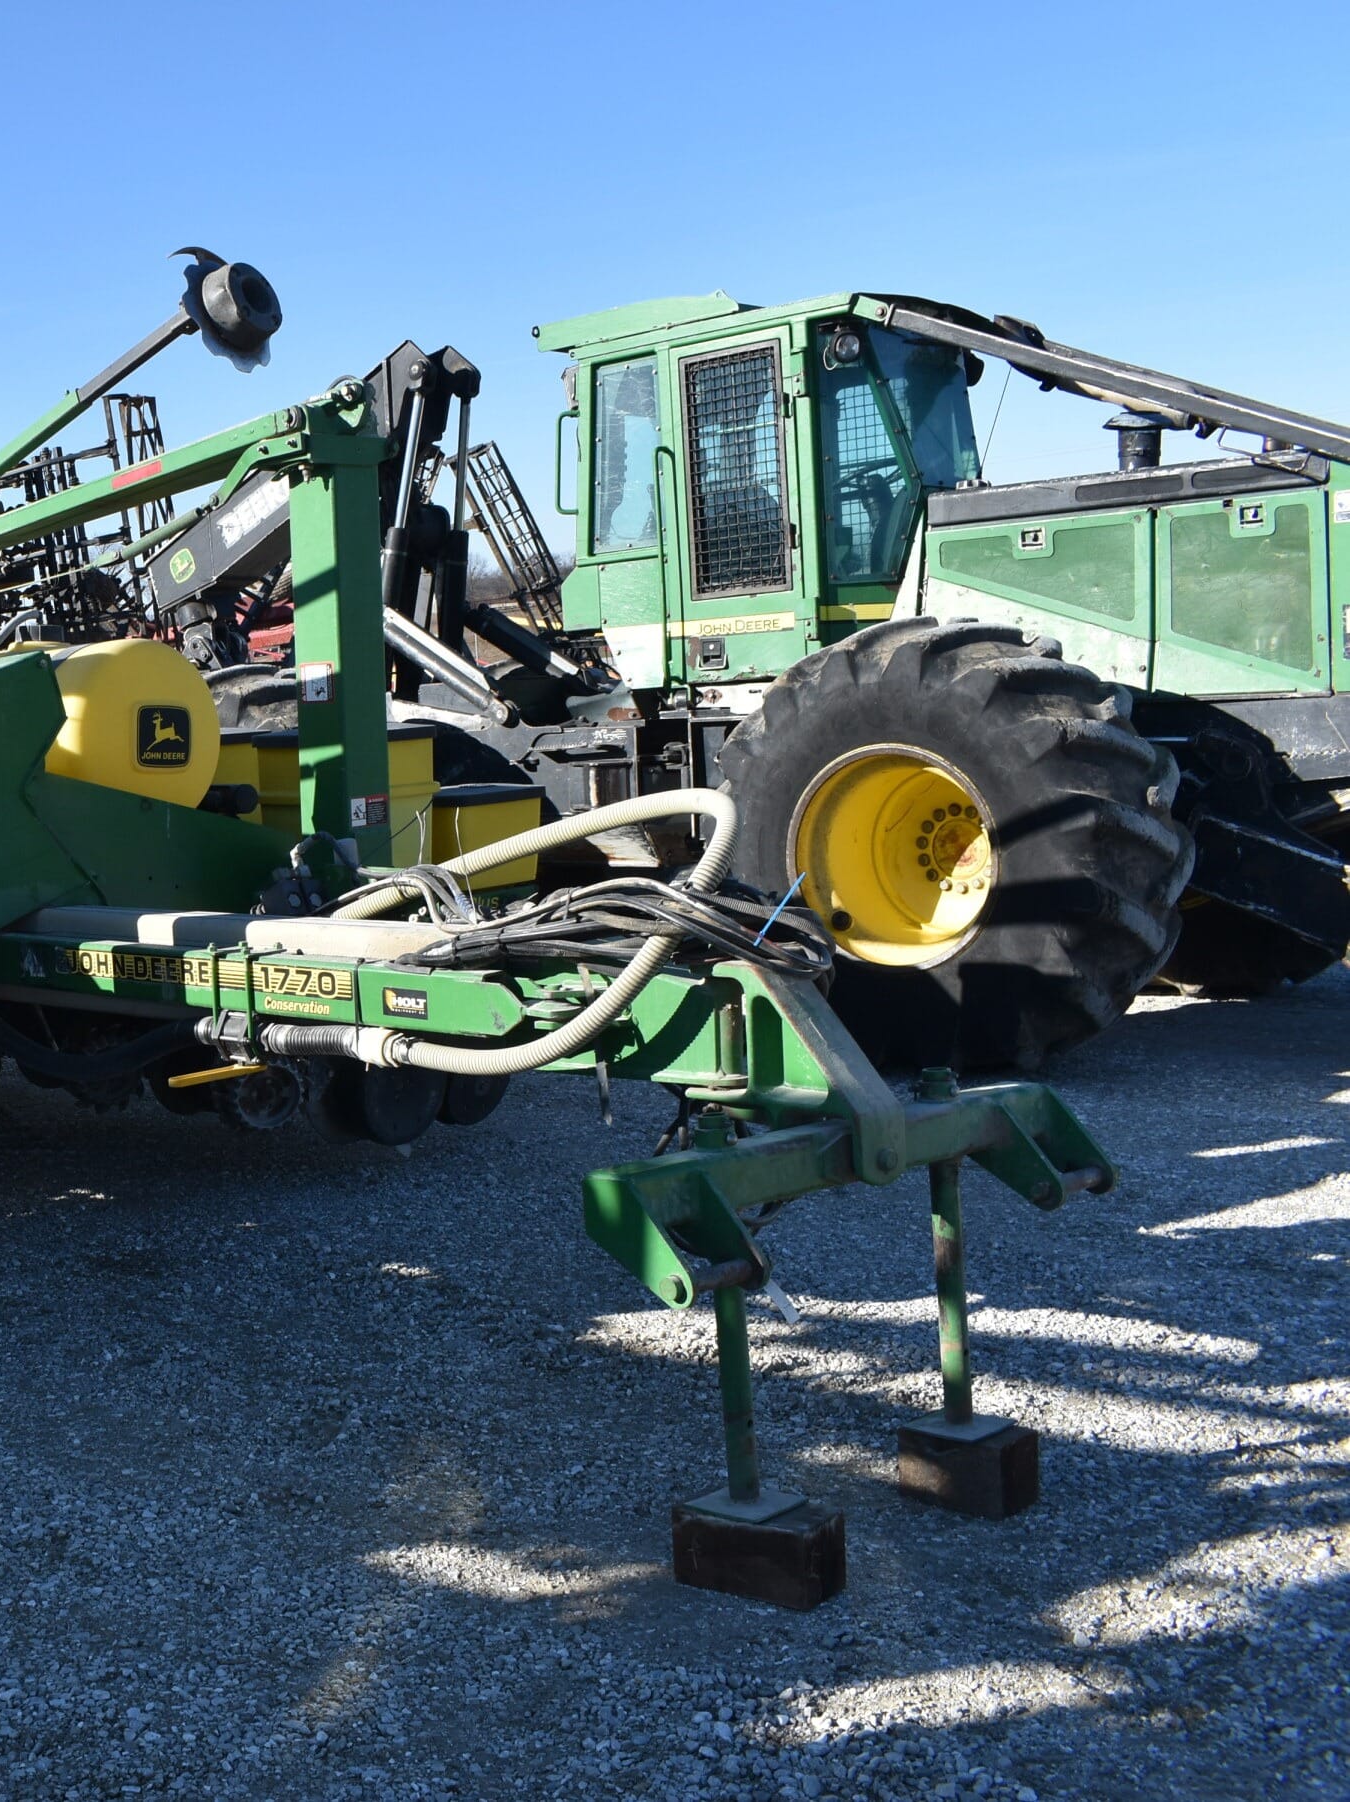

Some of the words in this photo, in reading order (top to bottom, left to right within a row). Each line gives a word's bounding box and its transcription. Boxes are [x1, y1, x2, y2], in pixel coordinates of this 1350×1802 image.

[698, 623, 732, 634] JOHN
[735, 619, 780, 631] DEERE
[141, 752, 161, 760] JOHN
[162, 752, 186, 760] DEERE
[65, 949, 127, 978] JOHN
[134, 956, 211, 985] DEERE
[260, 966, 337, 997] 1770
[263, 996, 331, 1016] Conservation
[392, 996, 427, 1009] HOLT
